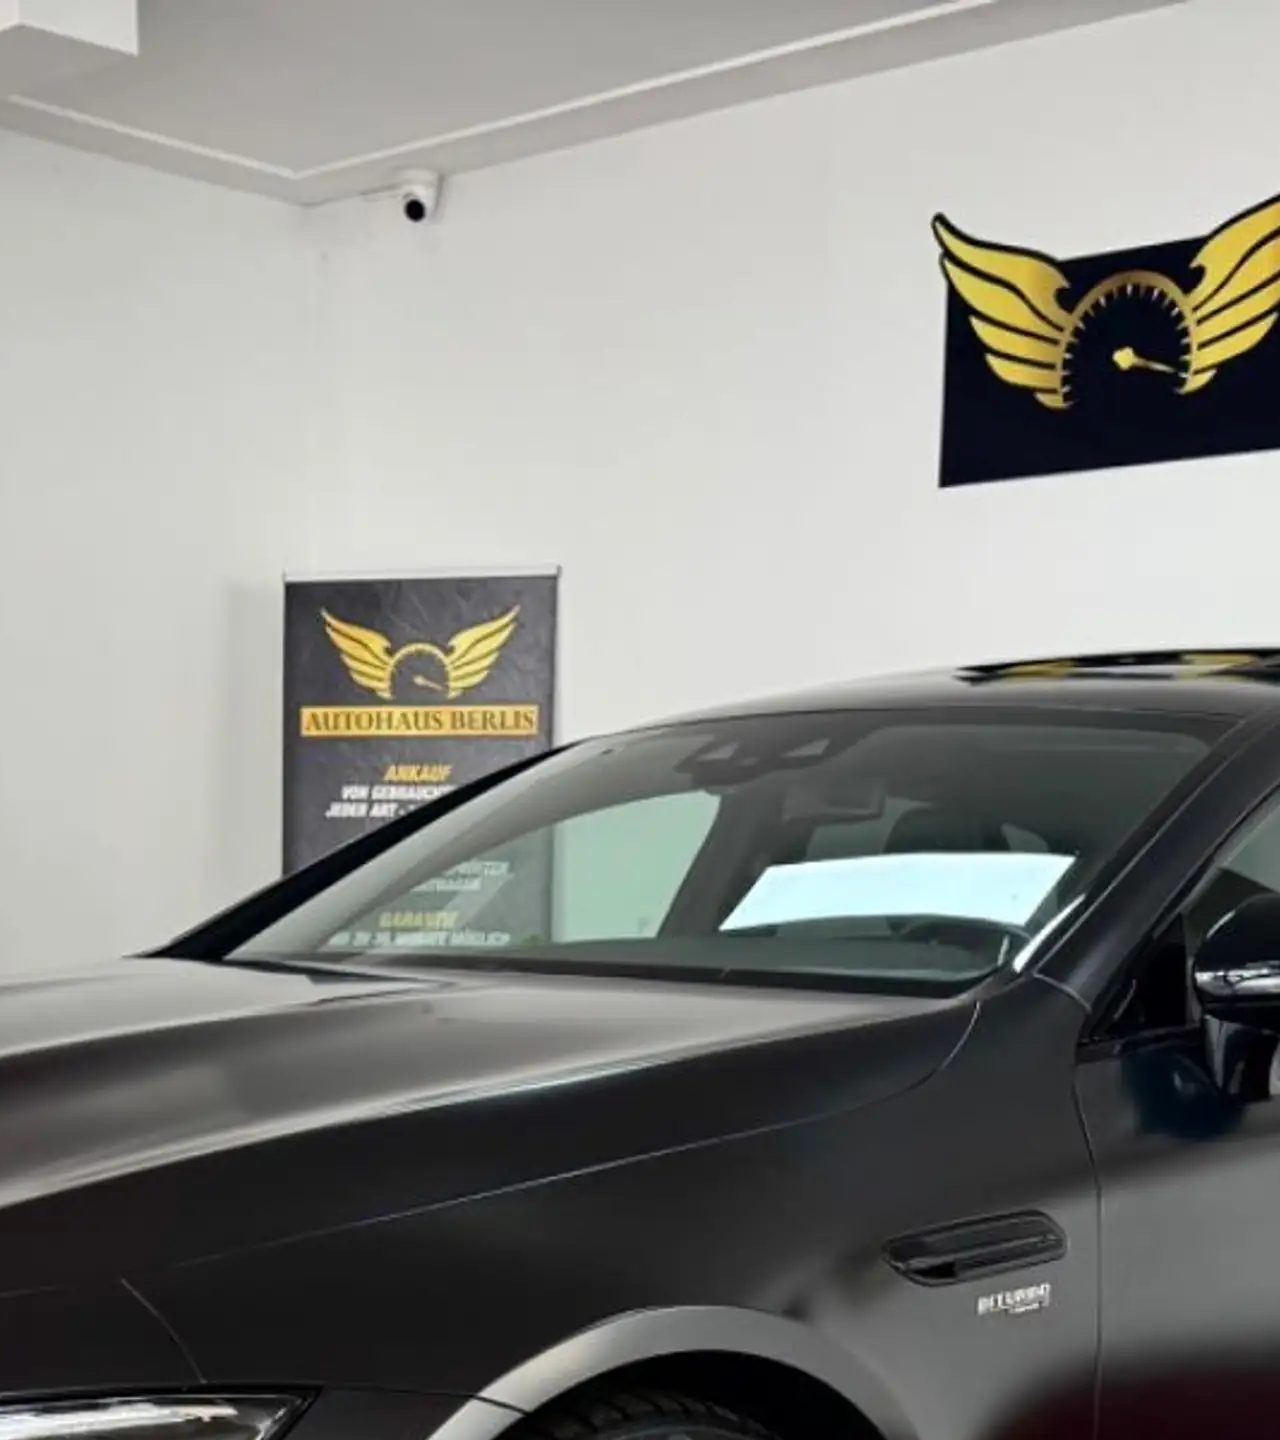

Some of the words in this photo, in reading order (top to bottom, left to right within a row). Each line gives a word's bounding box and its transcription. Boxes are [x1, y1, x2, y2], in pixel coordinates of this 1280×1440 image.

[305, 709, 445, 731] AUTOHAUS
[451, 709, 535, 731] BERLIS
[341, 785, 369, 800] VON
